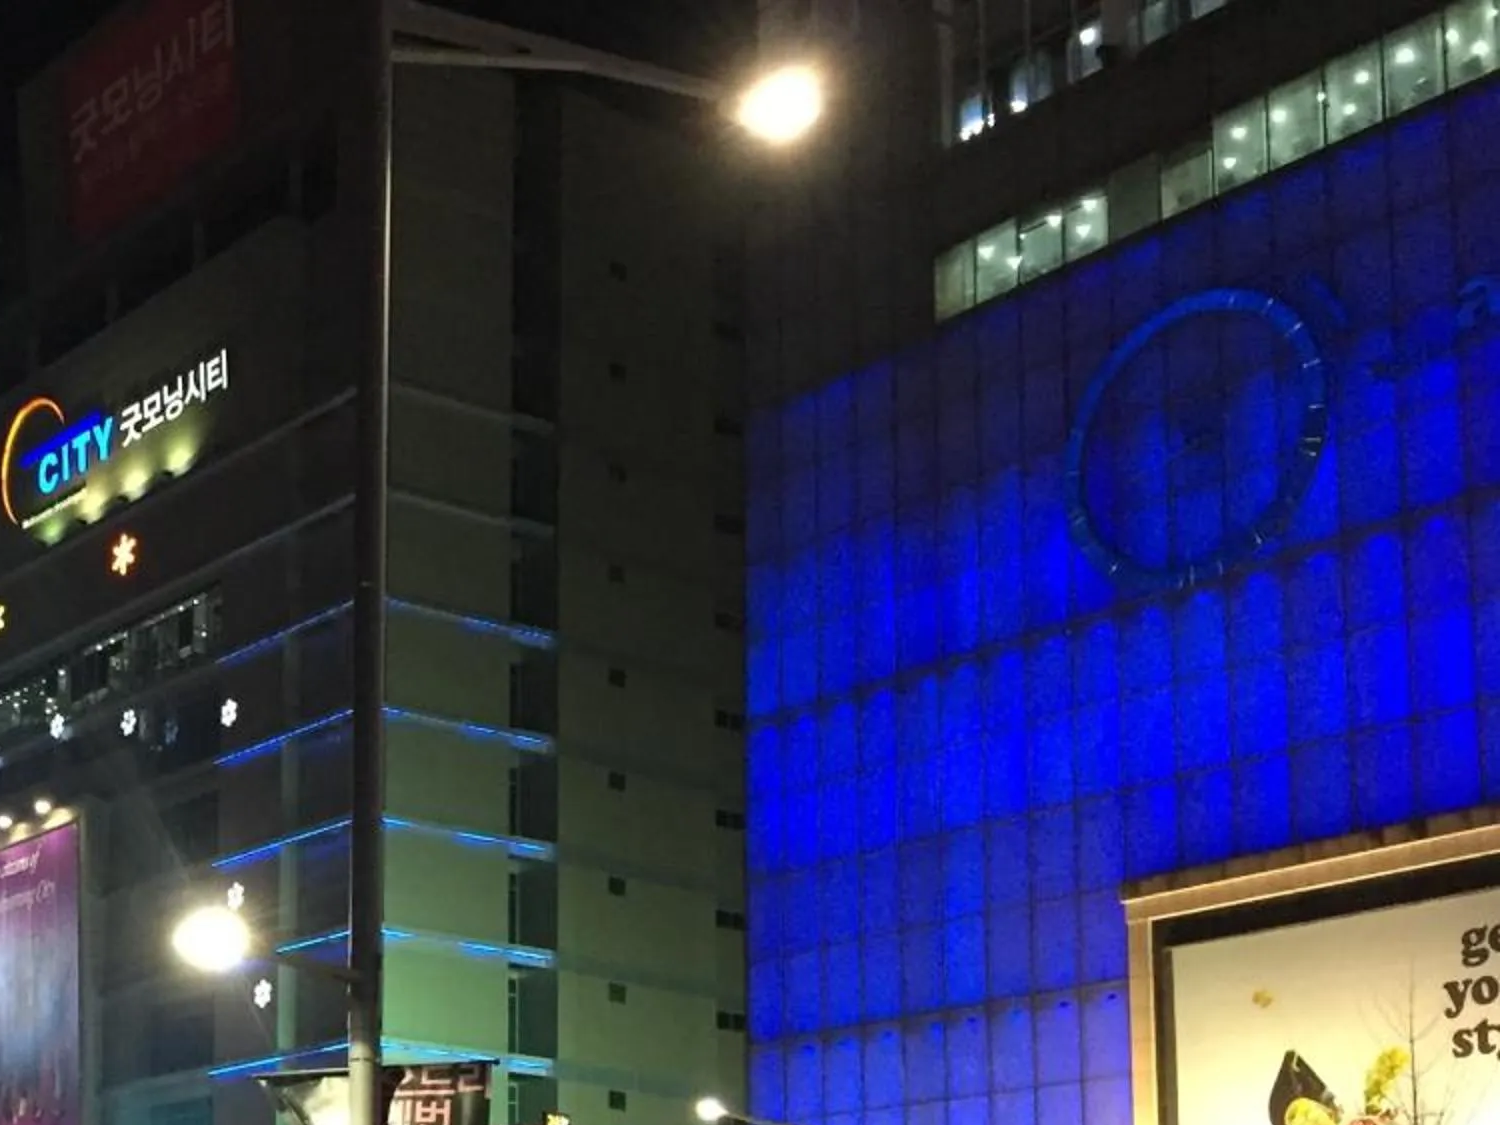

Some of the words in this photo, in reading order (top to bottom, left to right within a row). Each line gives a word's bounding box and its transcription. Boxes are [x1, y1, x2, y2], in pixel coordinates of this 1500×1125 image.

[70, 0, 235, 163] 굿모닝시티
[120, 348, 229, 447] 굿모닝시티
[38, 417, 114, 496] CITY
[1461, 925, 1500, 968] ge
[1443, 976, 1500, 1019] yo
[1452, 1019, 1500, 1058] st
